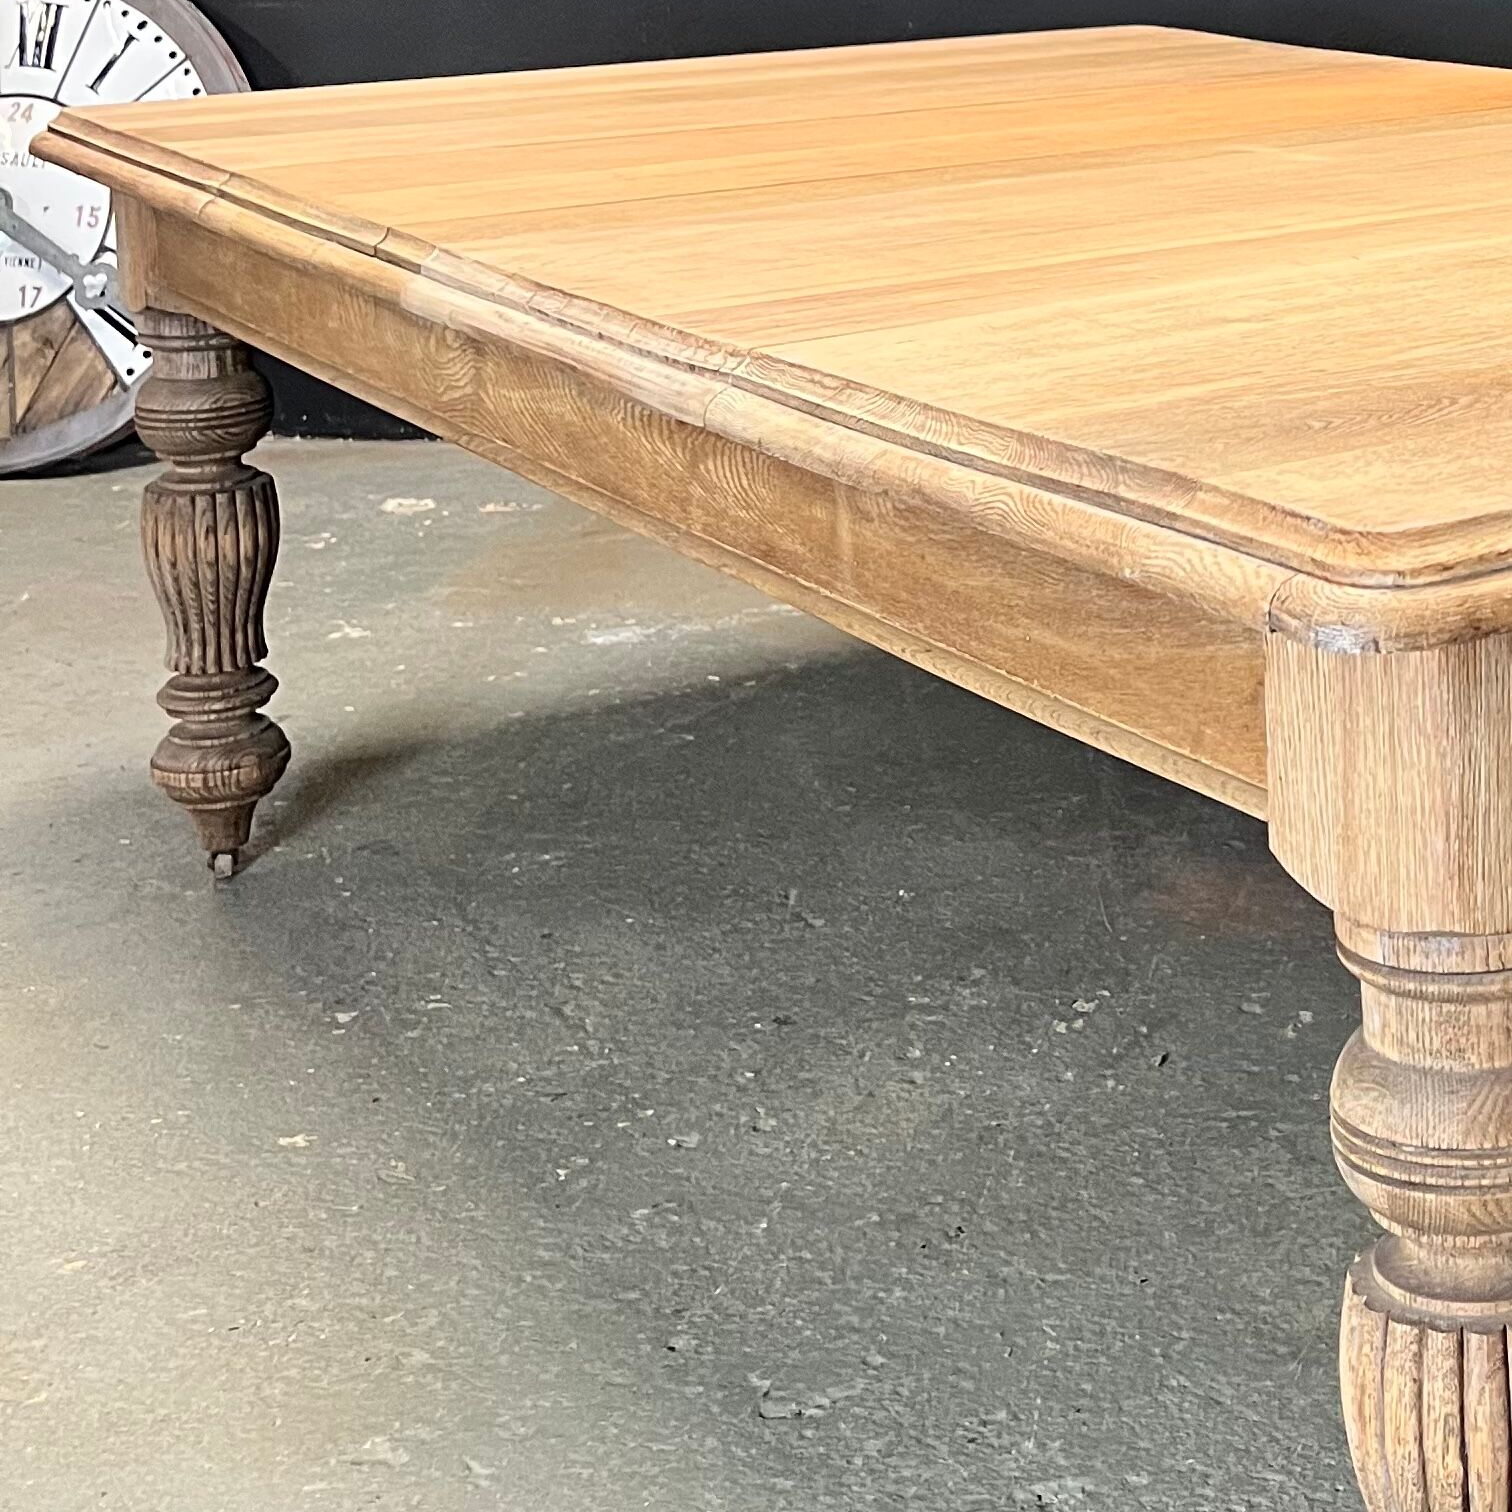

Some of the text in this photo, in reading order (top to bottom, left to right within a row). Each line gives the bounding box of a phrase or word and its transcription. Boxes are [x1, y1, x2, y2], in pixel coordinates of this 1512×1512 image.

[7, 101, 34, 123] 24
[75, 205, 101, 228] 15
[19, 285, 43, 308] 17
